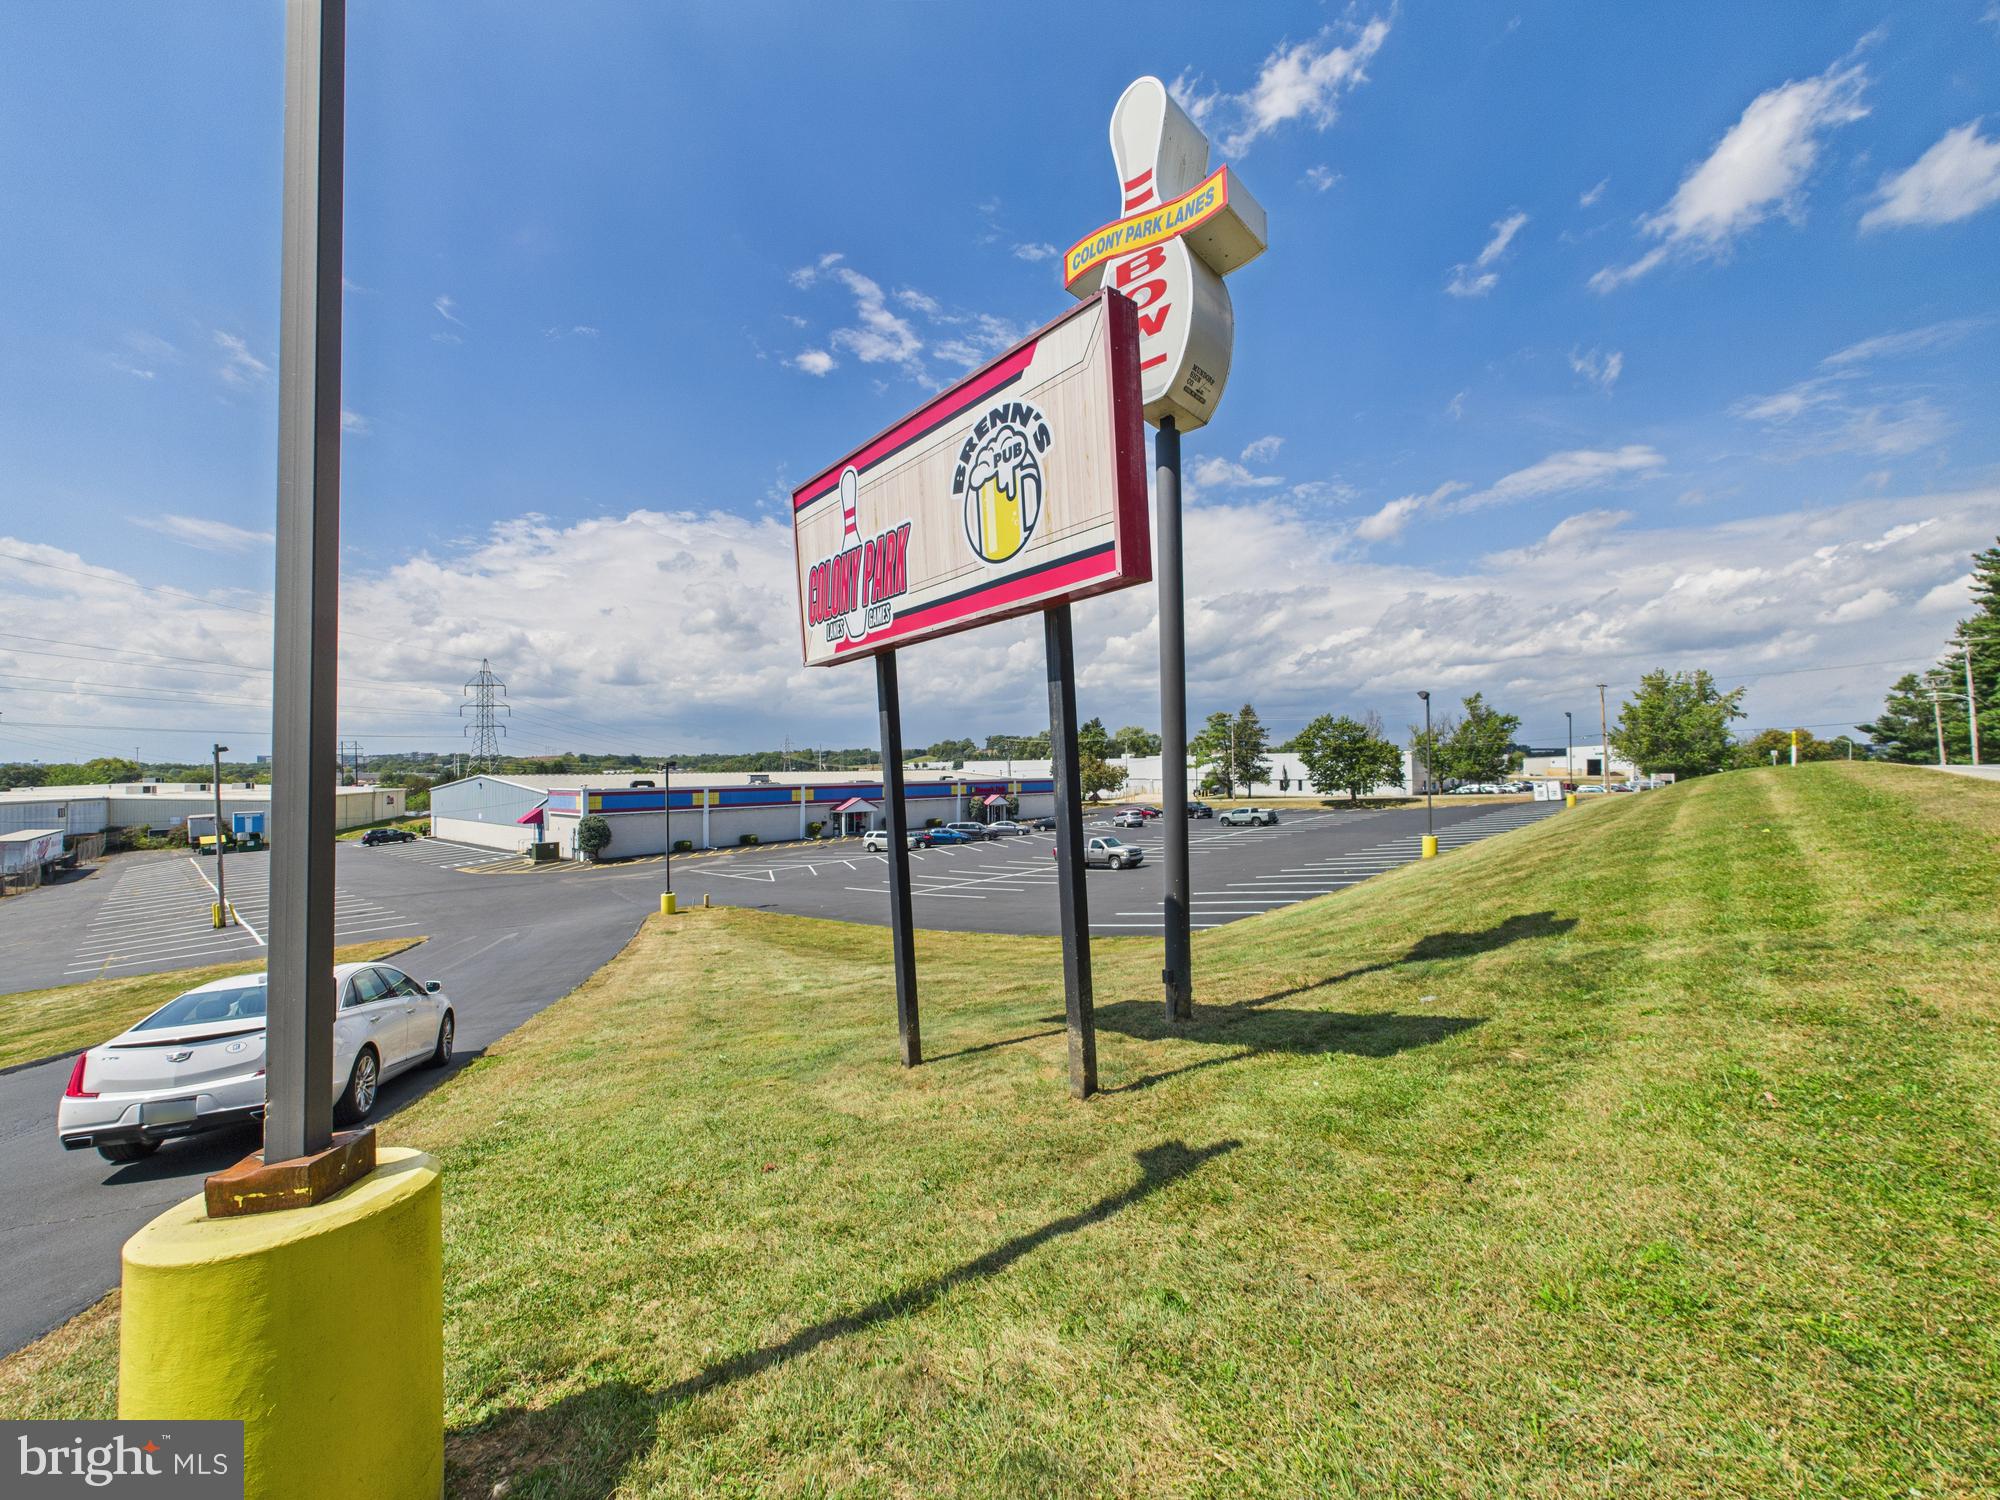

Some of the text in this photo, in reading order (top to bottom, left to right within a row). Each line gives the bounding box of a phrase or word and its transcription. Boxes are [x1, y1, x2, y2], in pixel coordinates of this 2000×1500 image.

[1072, 185, 1215, 270] COLONY PARK LANES
[952, 402, 1052, 495] BRENN'S
[993, 442, 1023, 469] PUB
[808, 522, 911, 627] COLONY PARK
[826, 602, 891, 642] LANES GAMES
